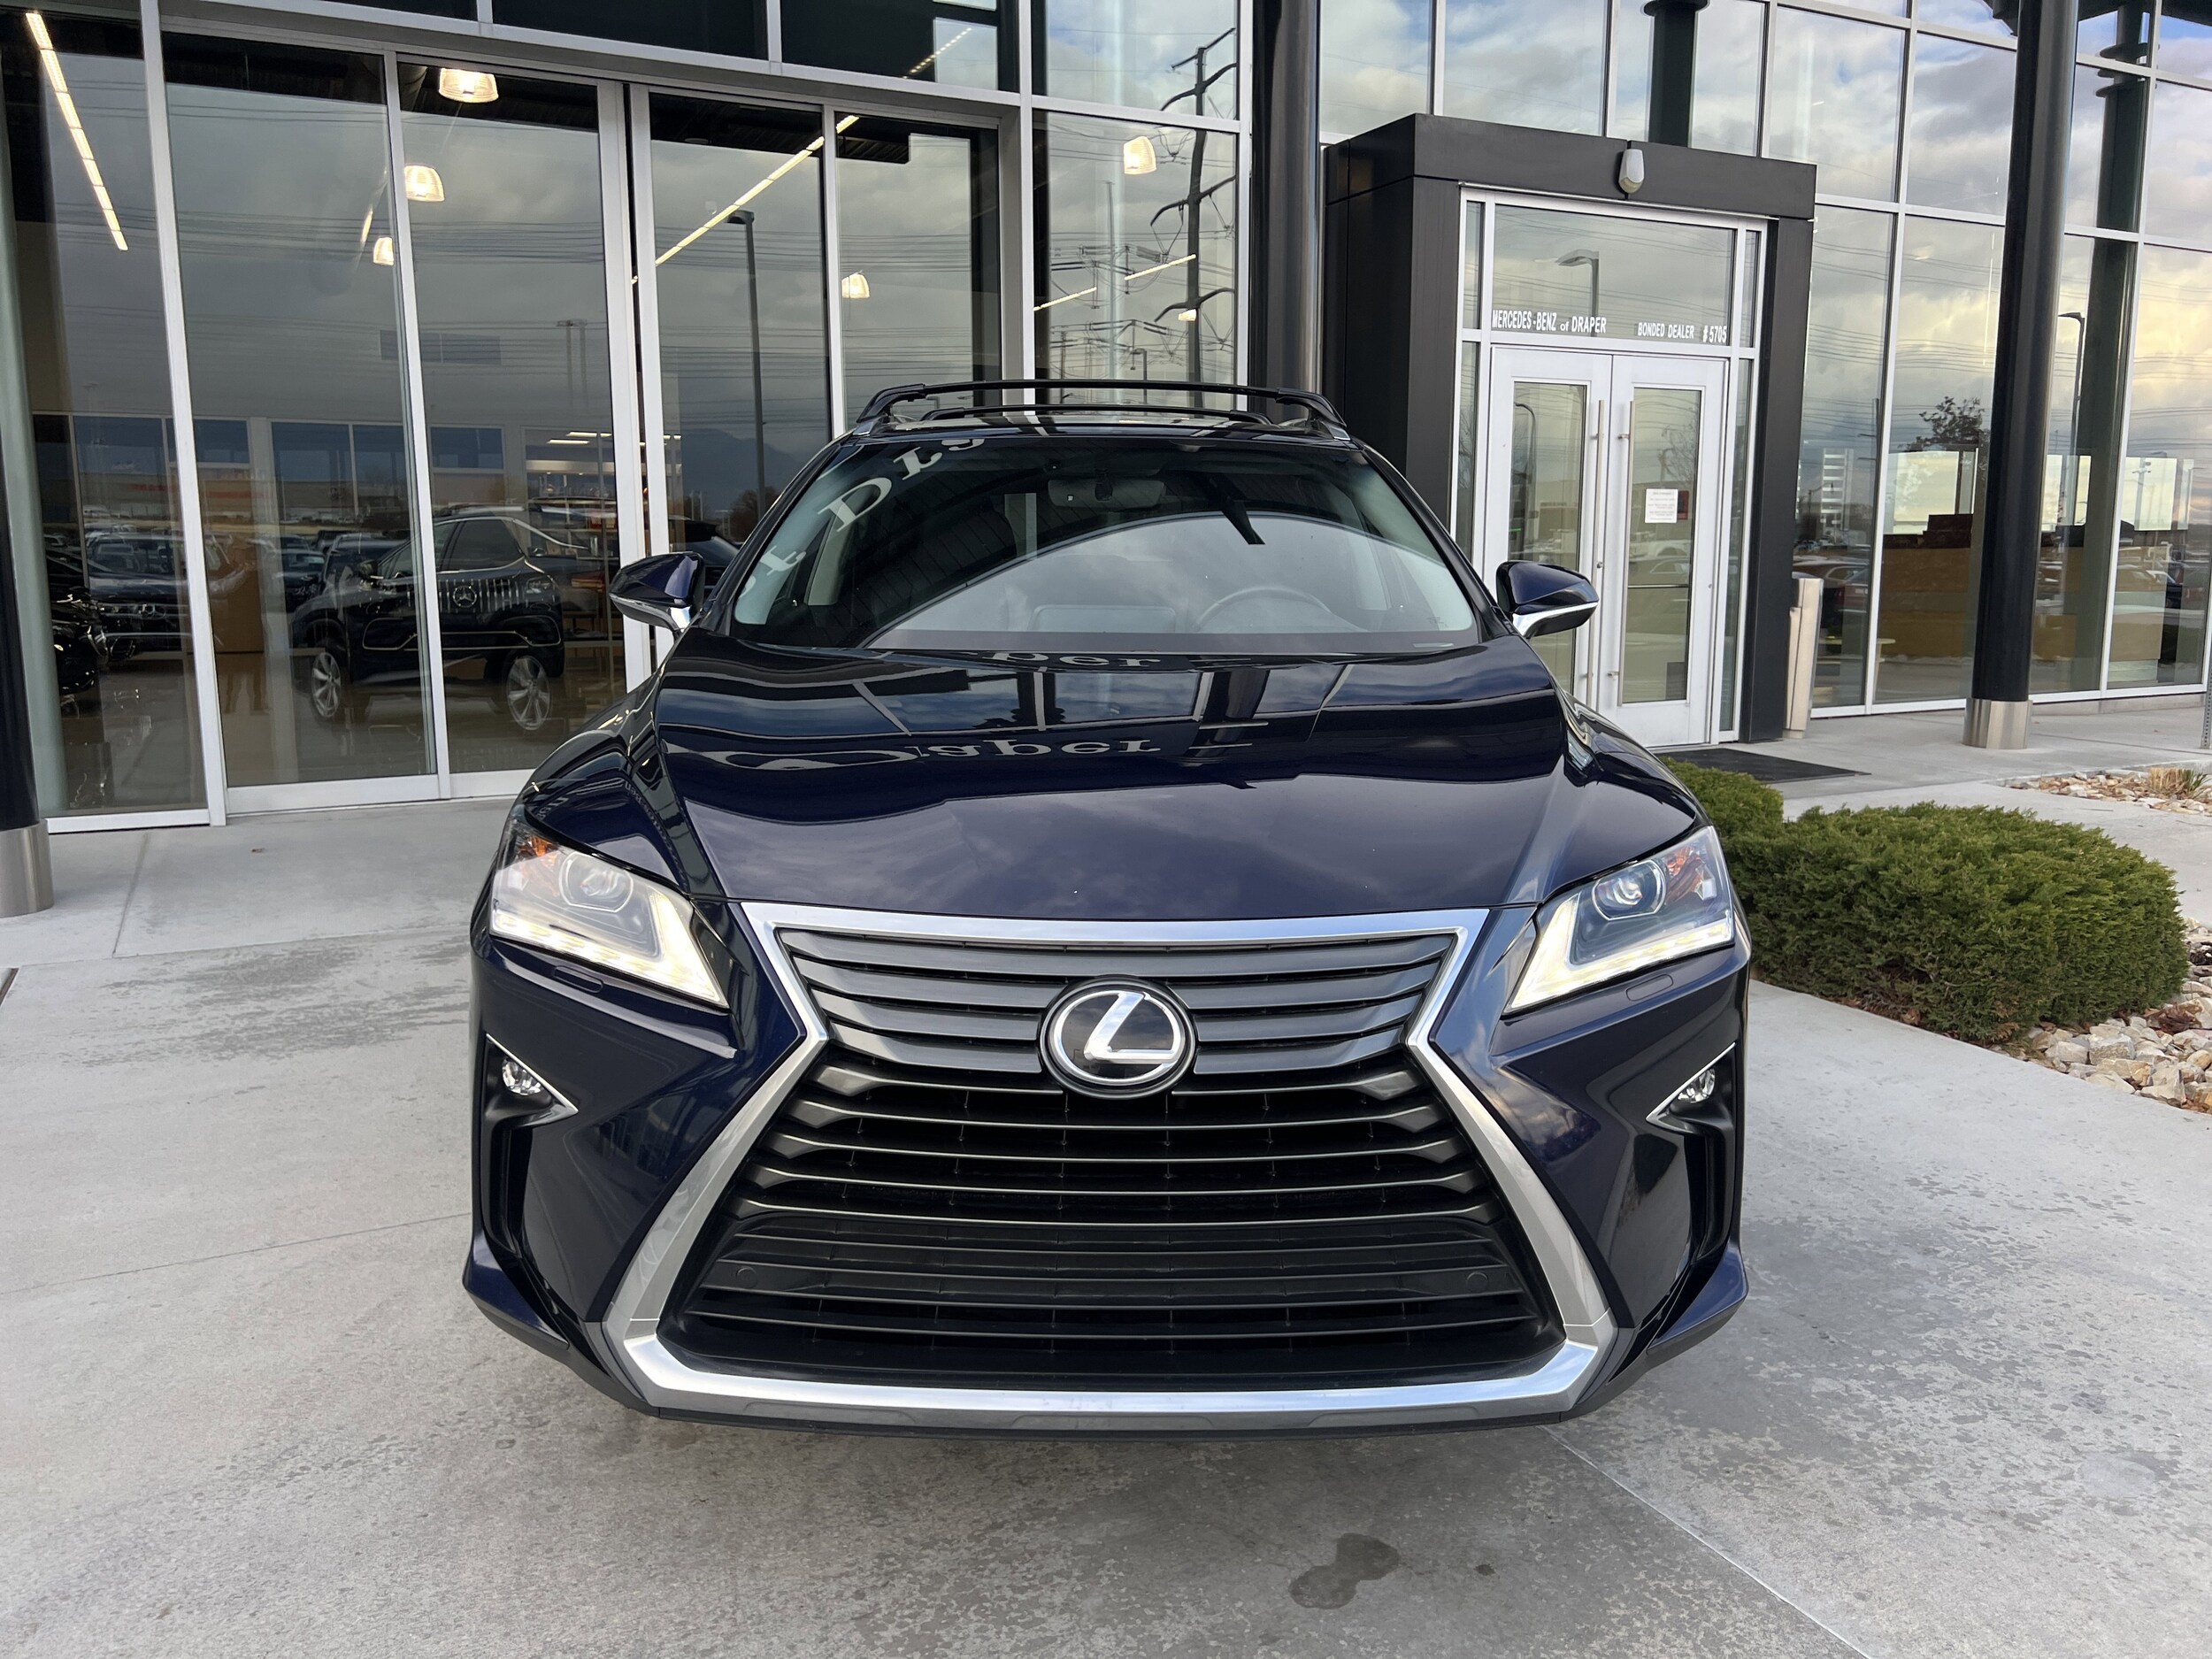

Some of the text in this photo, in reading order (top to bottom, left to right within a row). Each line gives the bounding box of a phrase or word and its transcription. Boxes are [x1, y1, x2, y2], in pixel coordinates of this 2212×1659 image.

[1492, 310, 1607, 334] MERCEDES-BENZ of DRAPER
[1638, 322, 1665, 337] BONDED
[1668, 324, 1694, 339] DEALER
